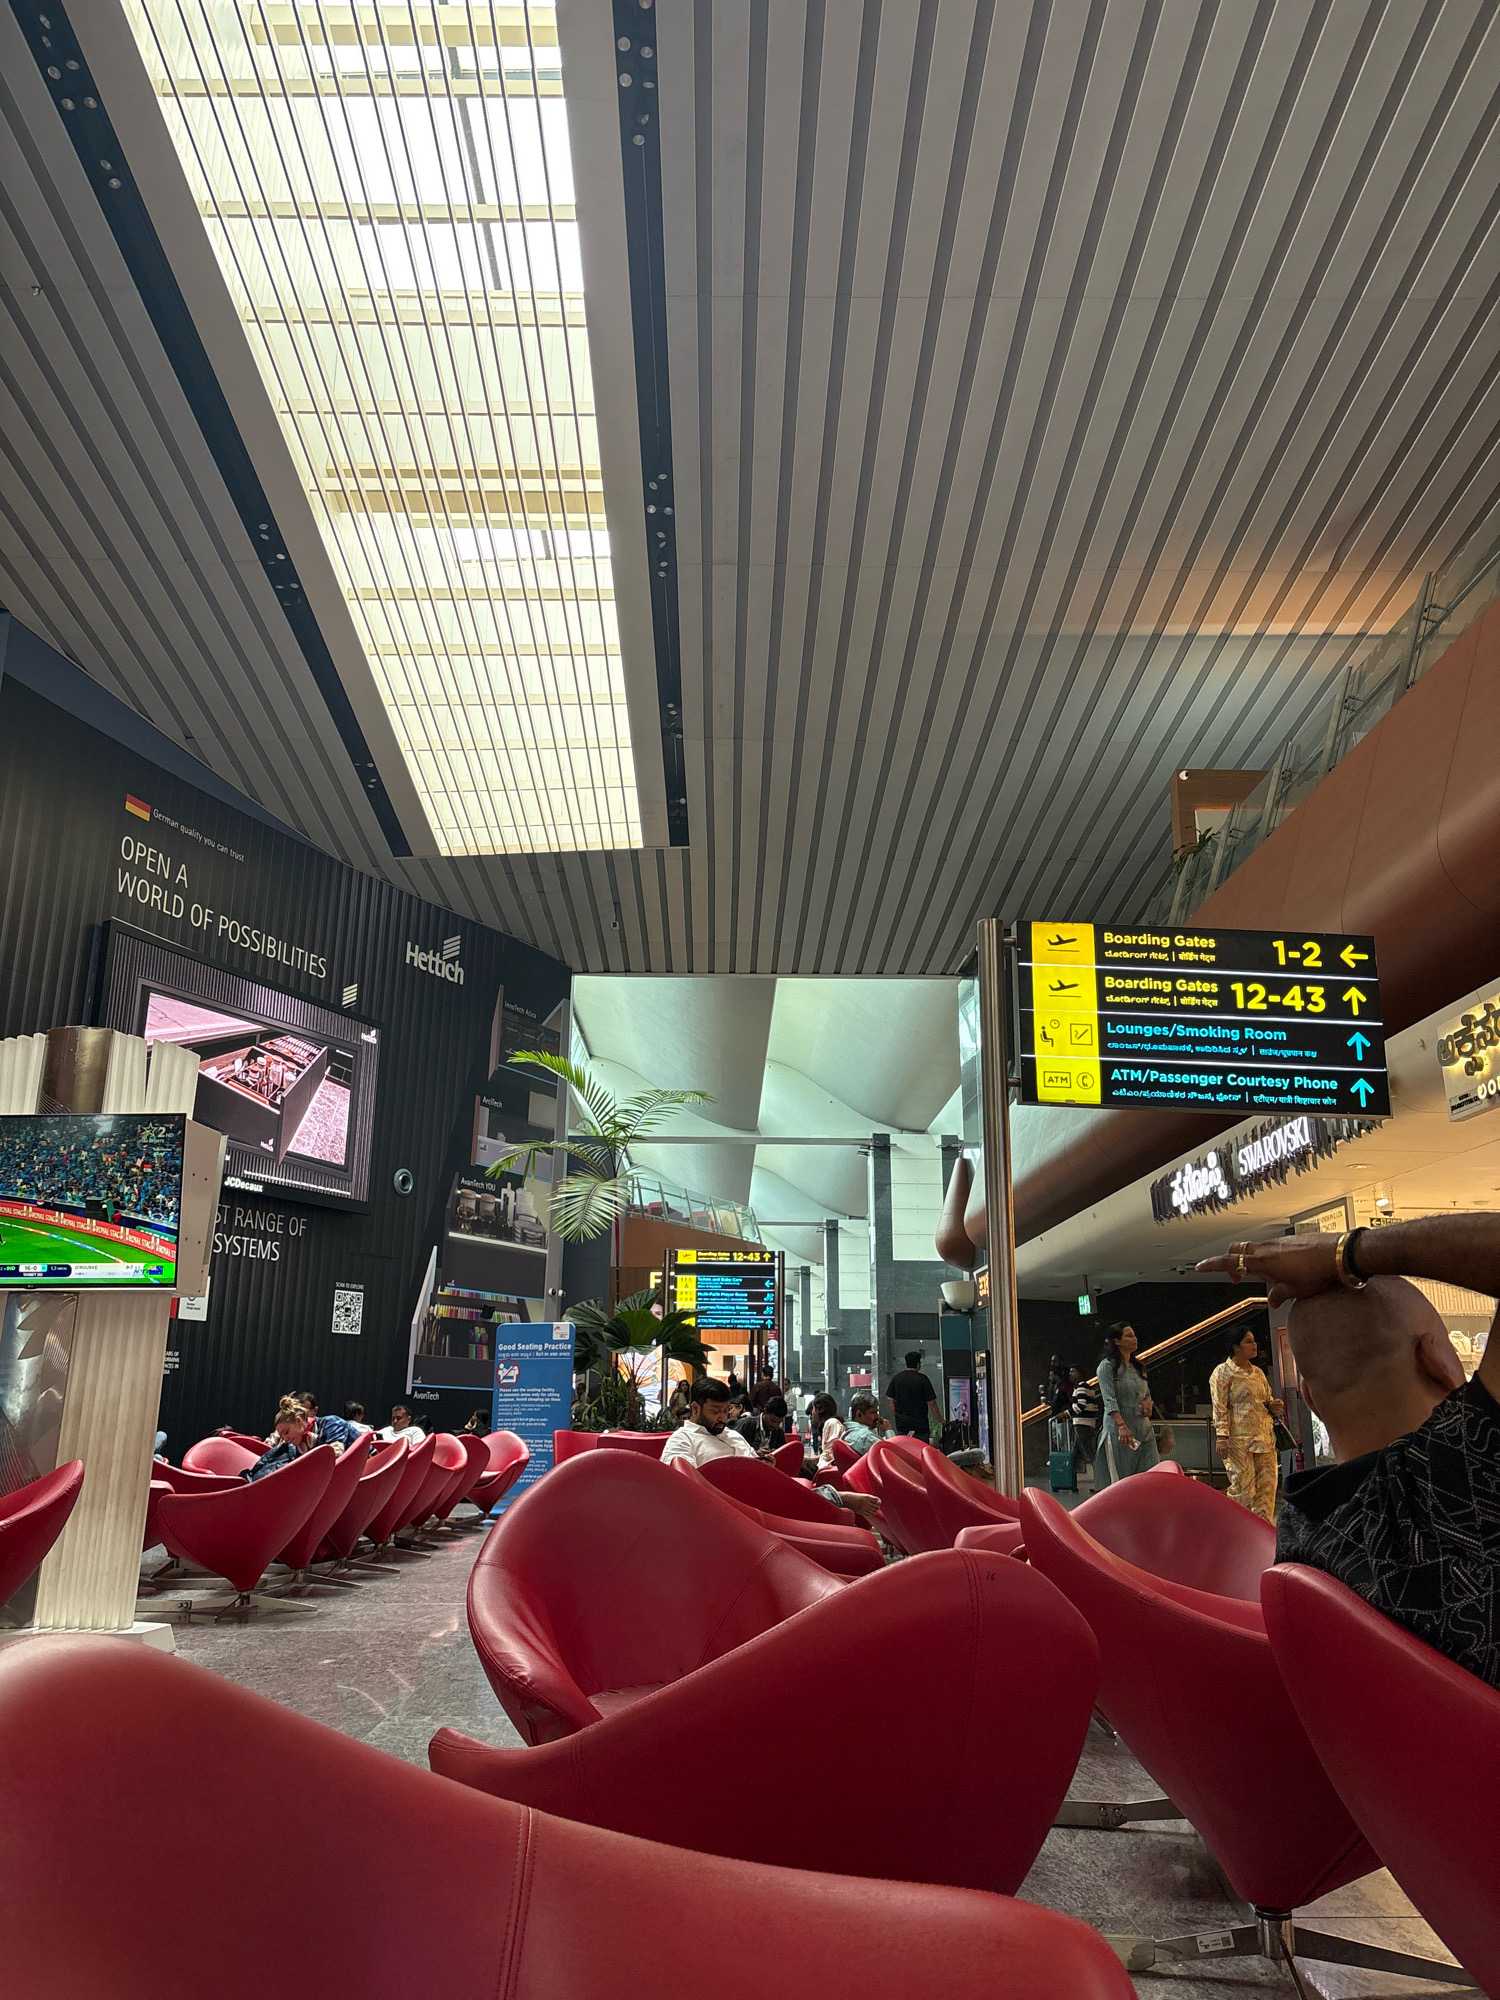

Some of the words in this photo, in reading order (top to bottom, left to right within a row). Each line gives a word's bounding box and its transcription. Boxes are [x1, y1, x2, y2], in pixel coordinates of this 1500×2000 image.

[153, 808, 179, 829] German
[180, 824, 202, 843] quality
[203, 835, 216, 847] you
[216, 843, 229, 854] can
[230, 848, 244, 862] trust
[121, 836, 171, 879] OPEN
[175, 864, 188, 888] A
[118, 868, 184, 919] WORLD
[190, 903, 214, 930] OF
[218, 914, 326, 978] POSSIBILITIES
[406, 941, 464, 986] Hettich
[1104, 932, 1170, 948] Boarding
[1174, 935, 1216, 948] Gates
[1272, 940, 1322, 968] 1-2
[1104, 976, 1172, 992] Boarding
[1176, 979, 1218, 993] Gates
[1230, 982, 1326, 1012] 12-43
[1107, 1022, 1240, 1041] Lounges/Smoking
[1244, 1028, 1287, 1041] Room
[1047, 1076, 1068, 1084] ATM
[1110, 1068, 1223, 1086] ATM/Passenger
[1227, 1074, 1290, 1090] Courtesy
[1294, 1076, 1338, 1090] Phone
[482, 1096, 502, 1108] ArciTech
[1238, 1116, 1310, 1176] SWAROVSKI
[224, 1176, 264, 1193] JCDecaux
[486, 1182, 496, 1192] YOU
[234, 1207, 284, 1234] RANGE
[288, 1216, 307, 1236] OF
[213, 1232, 280, 1262] SYSTEMS
[732, 1252, 760, 1262] 12-43
[517, 1342, 542, 1351] Seating
[544, 1342, 572, 1350] Practice
